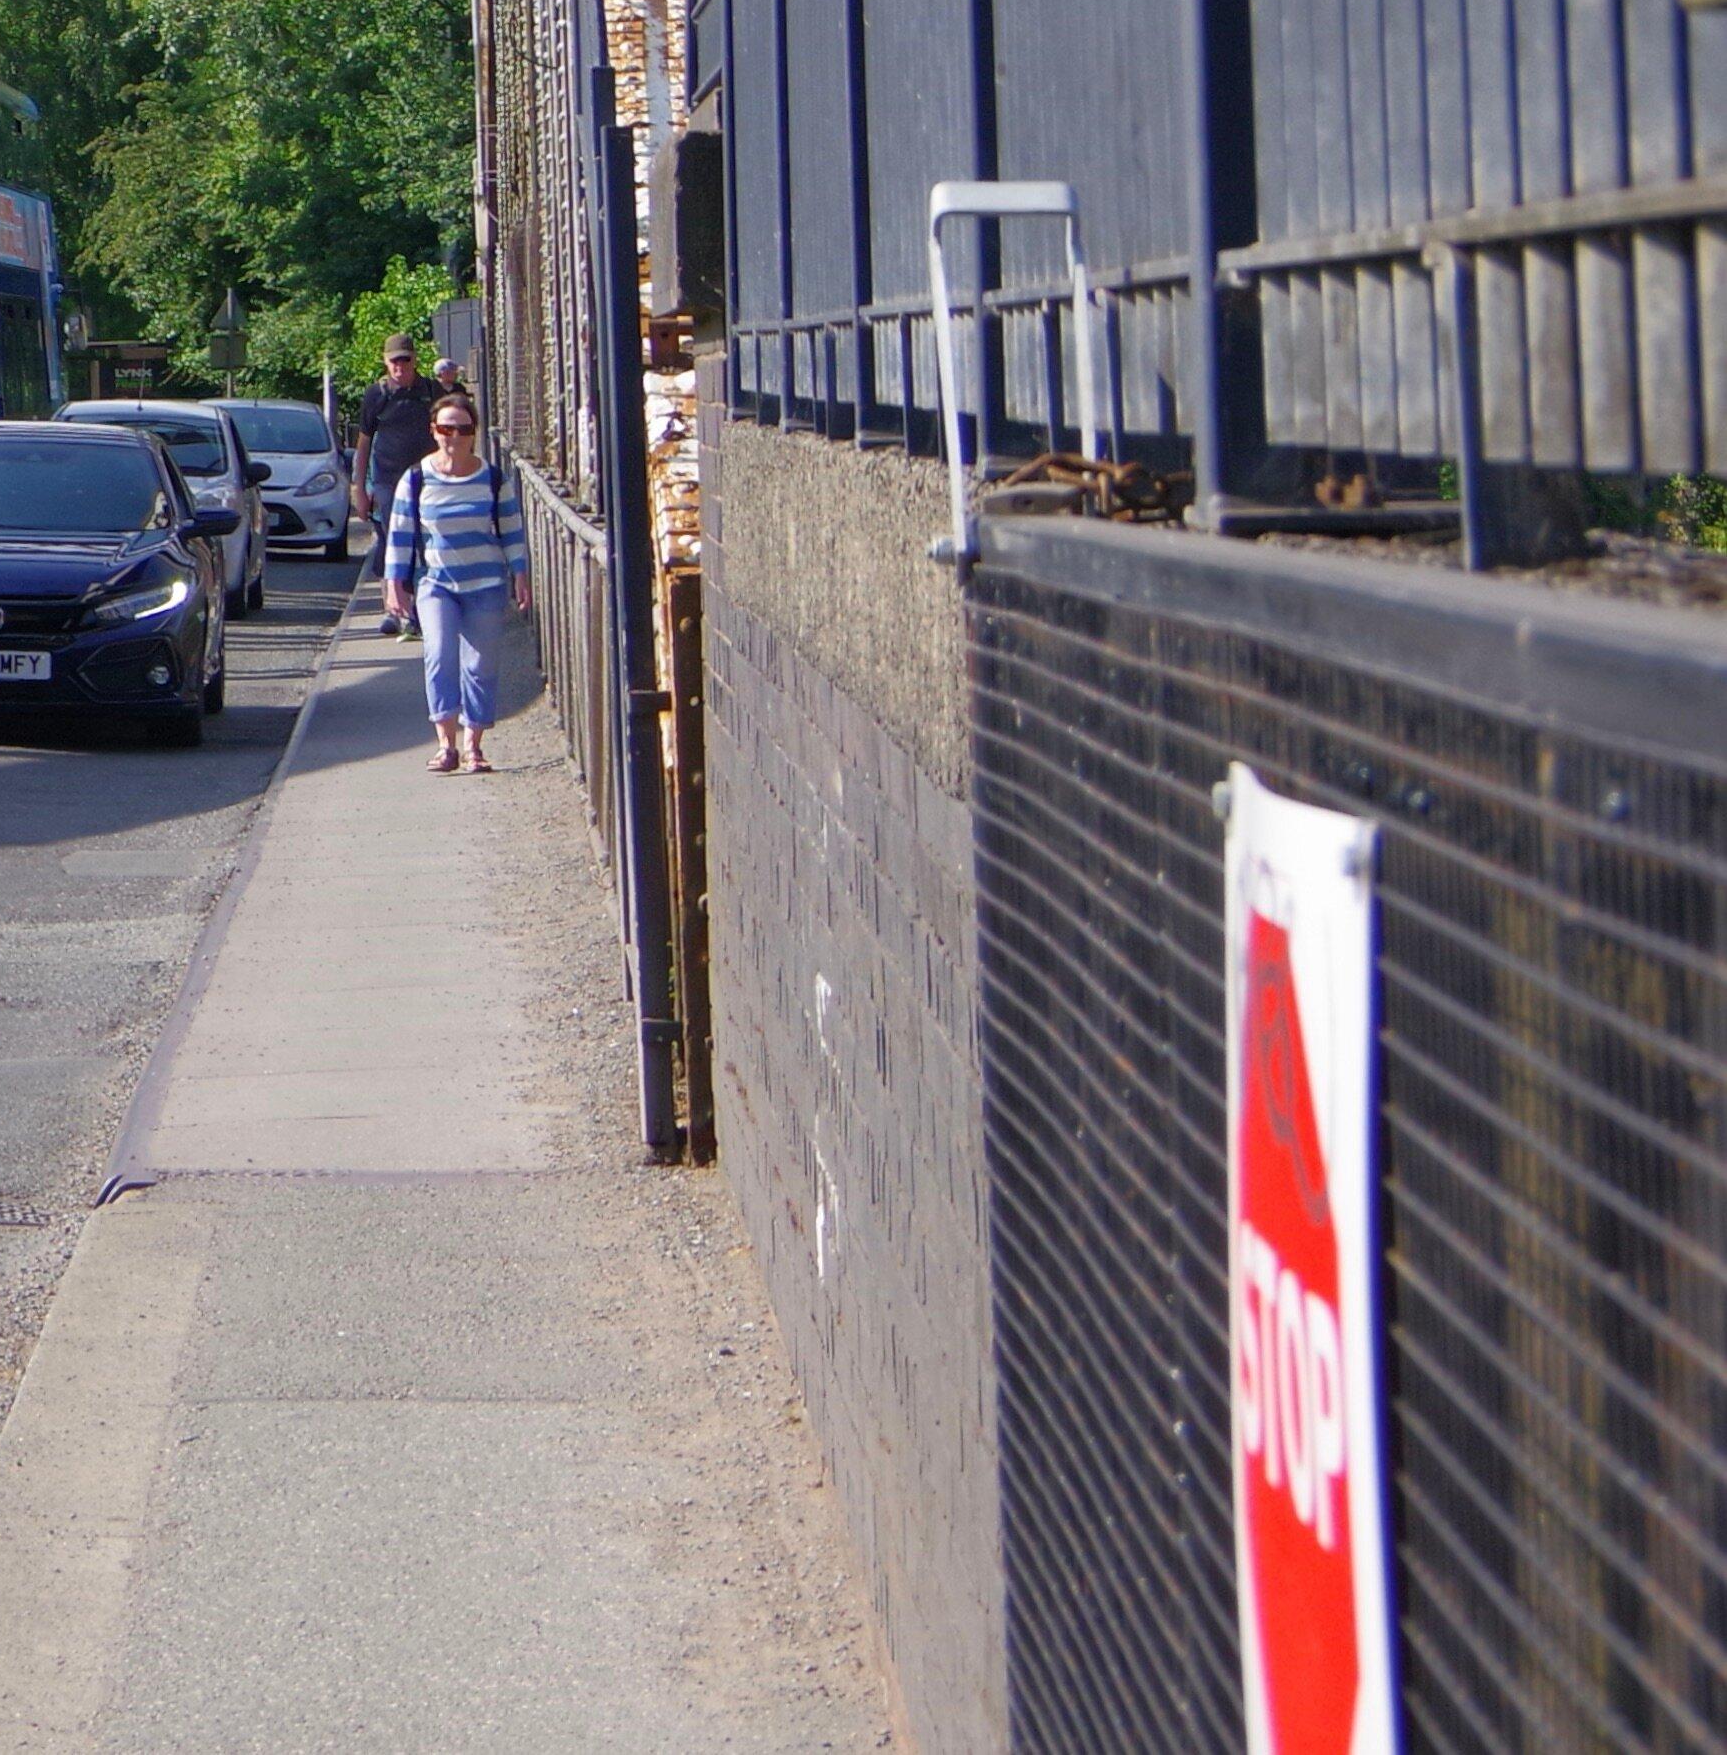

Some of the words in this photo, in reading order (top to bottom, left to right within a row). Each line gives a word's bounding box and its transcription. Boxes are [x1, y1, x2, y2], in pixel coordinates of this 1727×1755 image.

[114, 367, 153, 378] LYNX
[0, 654, 41, 675] MFY
[1239, 1219, 1344, 1550] STOP
